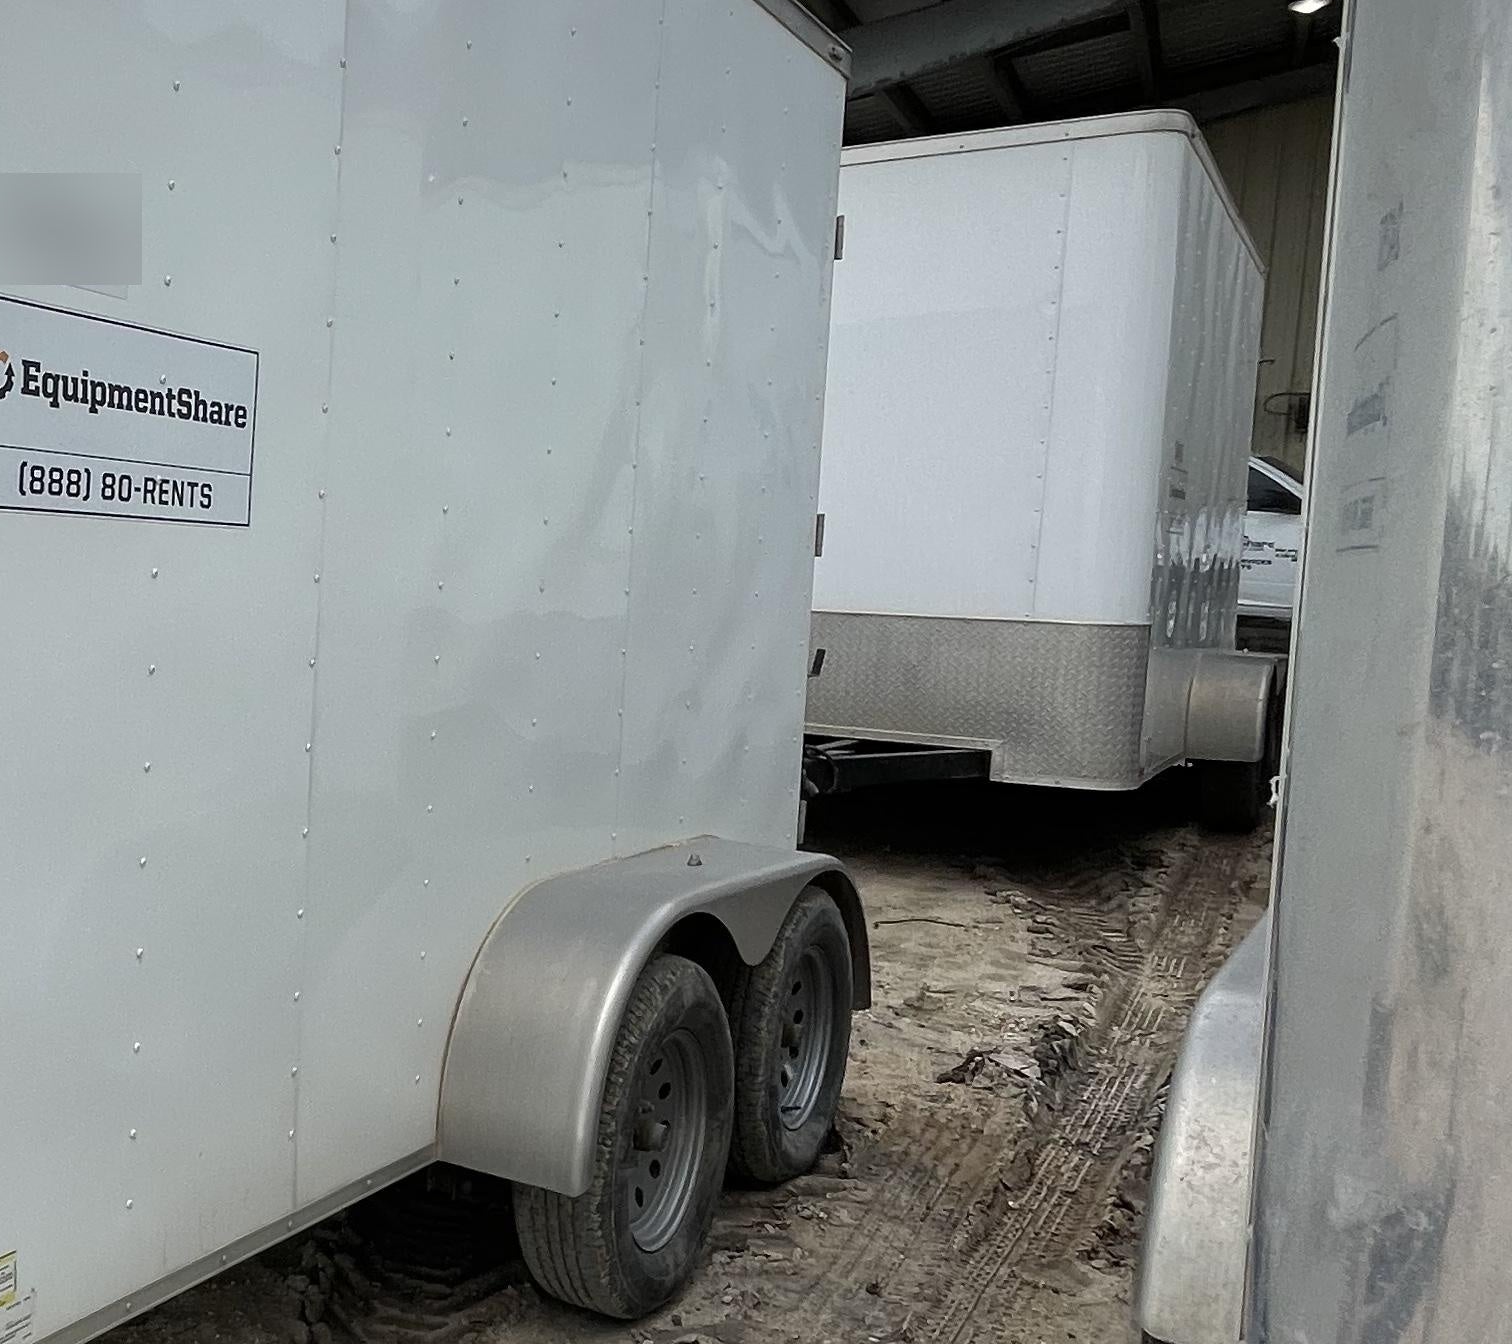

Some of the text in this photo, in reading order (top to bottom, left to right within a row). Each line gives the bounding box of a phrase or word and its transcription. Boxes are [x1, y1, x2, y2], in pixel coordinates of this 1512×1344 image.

[20, 359, 248, 429] EquipmentShare
[19, 461, 213, 509] (888) 80-RENTS
